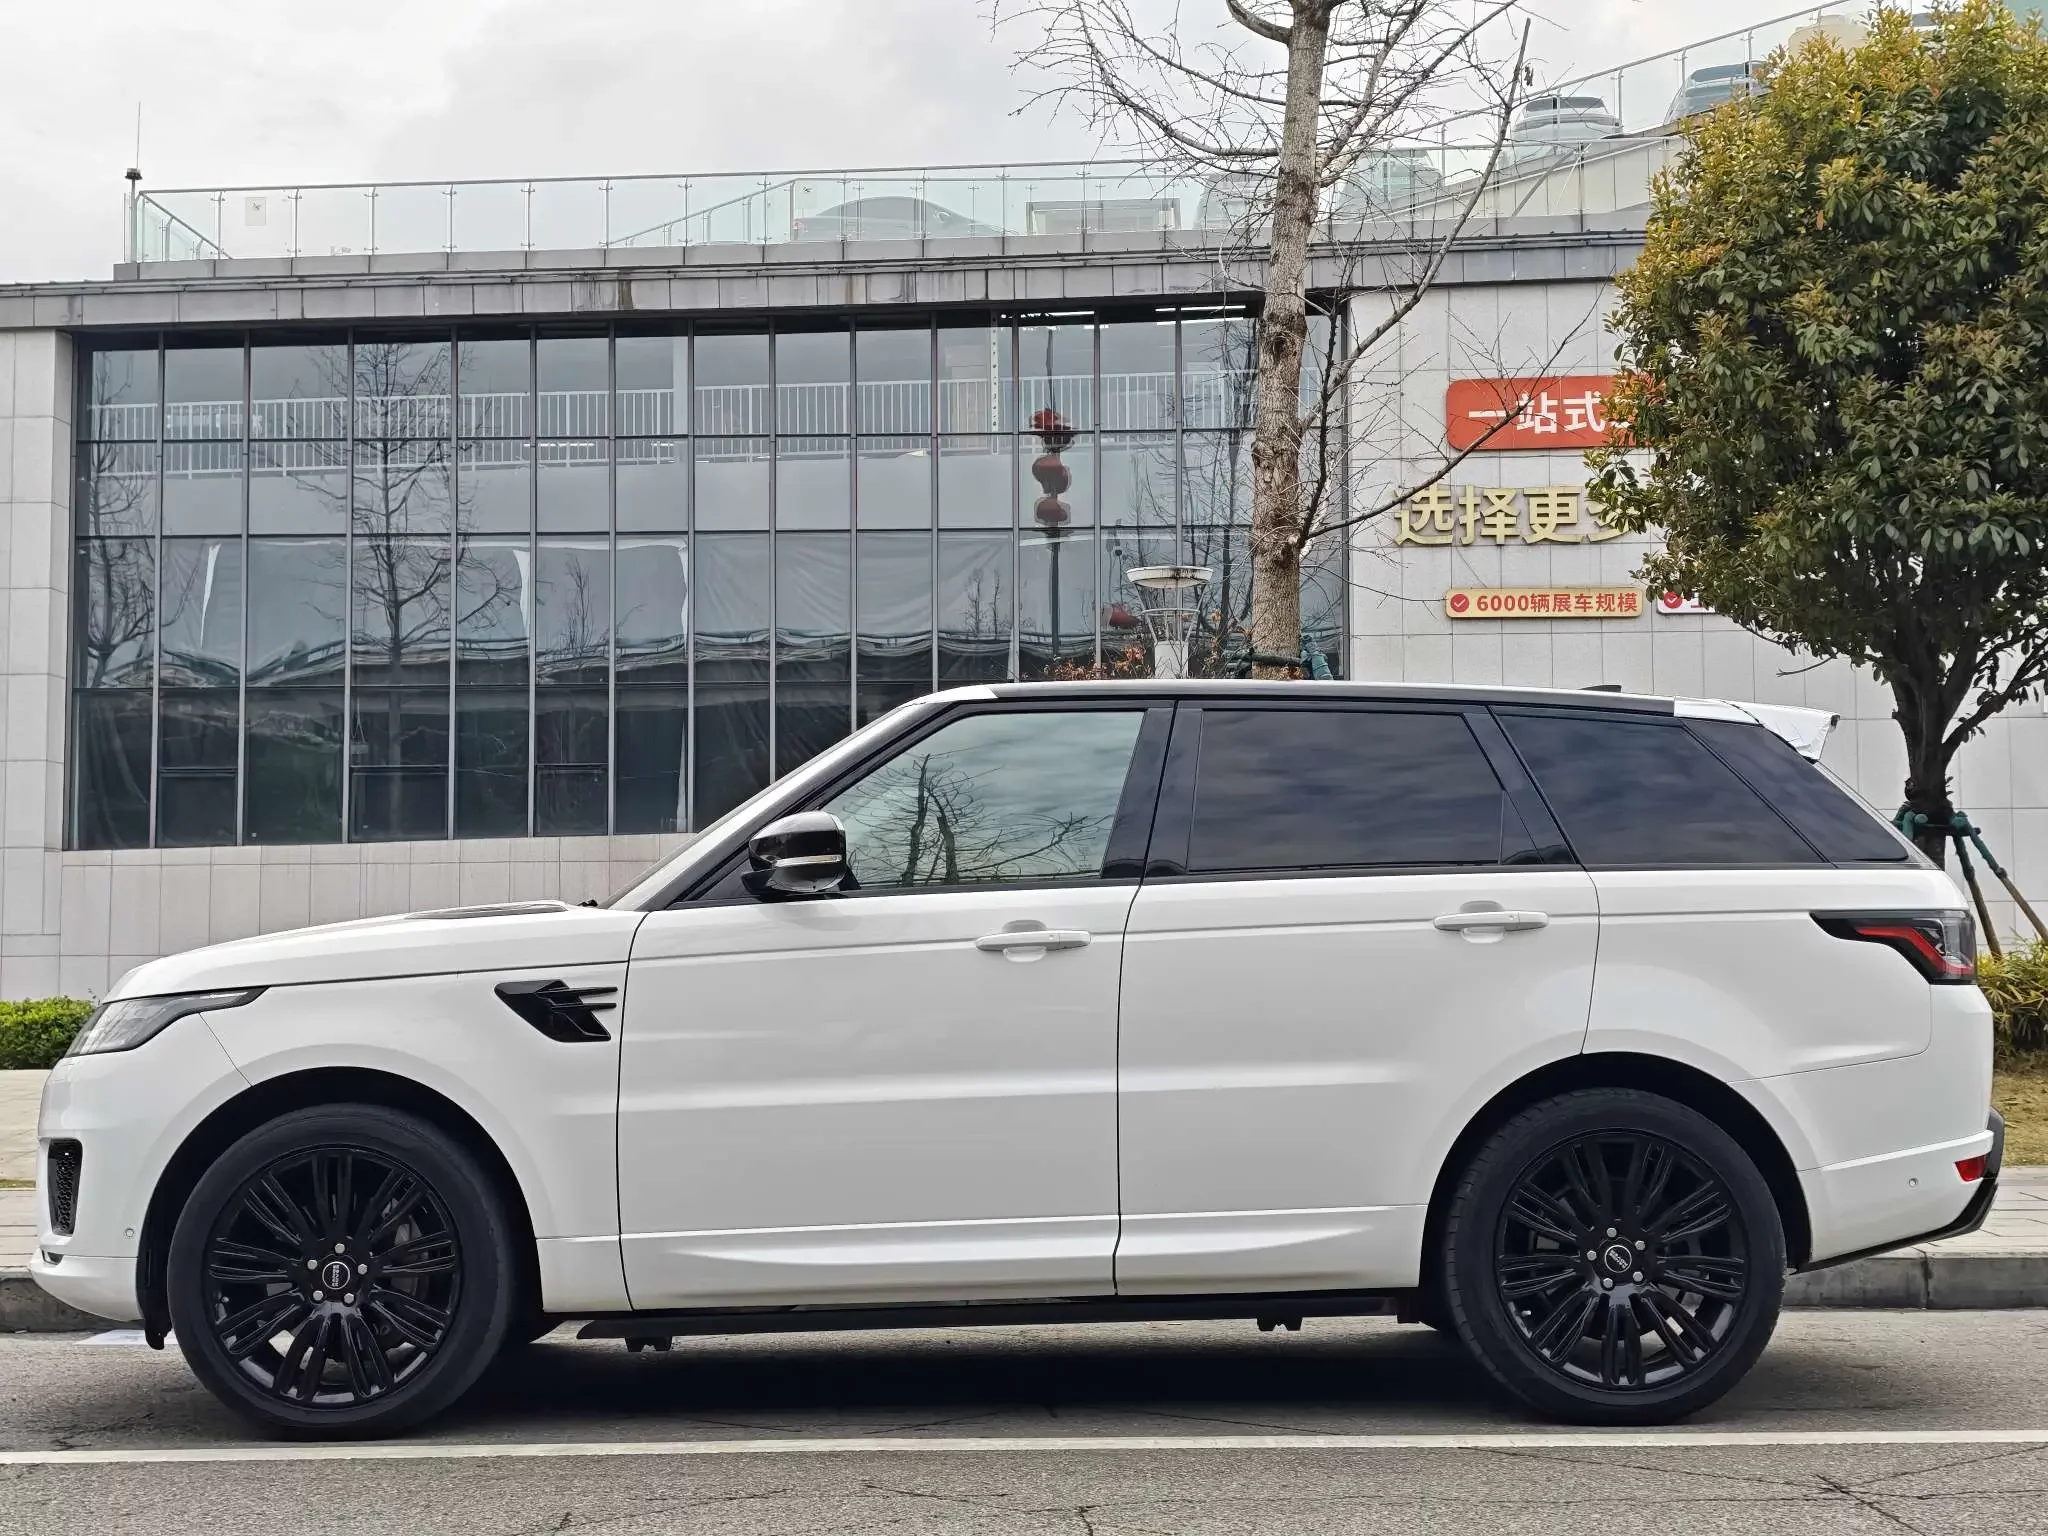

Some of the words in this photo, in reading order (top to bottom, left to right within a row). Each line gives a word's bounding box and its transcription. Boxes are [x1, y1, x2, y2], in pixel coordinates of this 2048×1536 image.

[1468, 390, 1631, 434] 一站式
[1476, 592, 1638, 613] 6000辆展车规模
